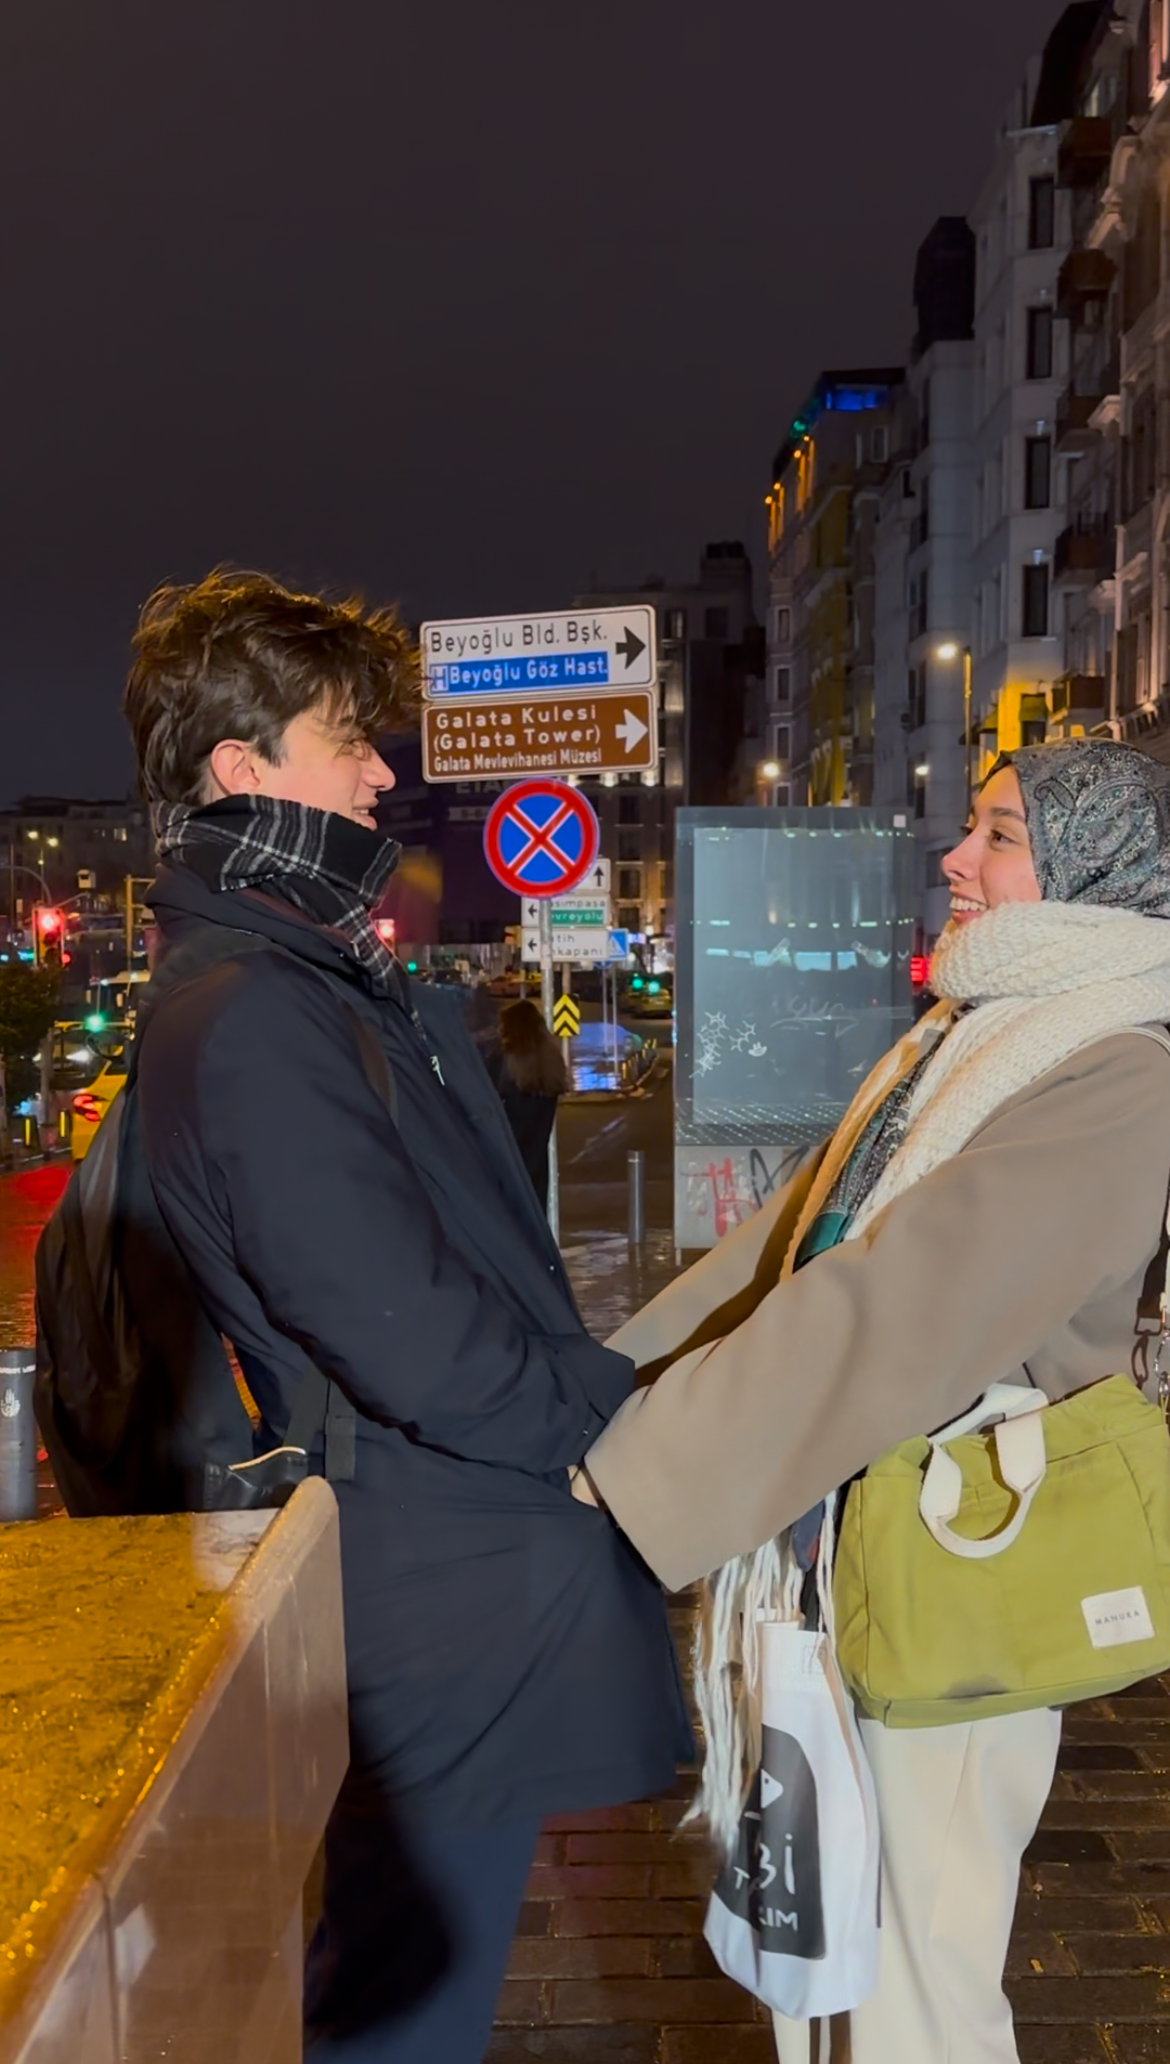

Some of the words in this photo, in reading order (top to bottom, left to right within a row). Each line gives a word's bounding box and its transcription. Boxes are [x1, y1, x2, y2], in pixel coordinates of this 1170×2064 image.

[431, 627, 513, 657] Beyoğlu
[523, 622, 560, 646] Bld.
[567, 619, 607, 645] Bşk.
[449, 662, 520, 688] Beyoğlu
[527, 659, 558, 679] Göz
[564, 656, 608, 677] Hast.
[436, 711, 512, 729] Galata
[522, 704, 596, 724] Kulesi
[433, 731, 516, 754] (Galata
[523, 724, 601, 745] Tower)
[434, 754, 471, 772] Galata
[474, 750, 557, 770] Mevlevihanesi
[560, 747, 602, 765] Müzesi
[1094, 1609, 1141, 1625] MANUKA
